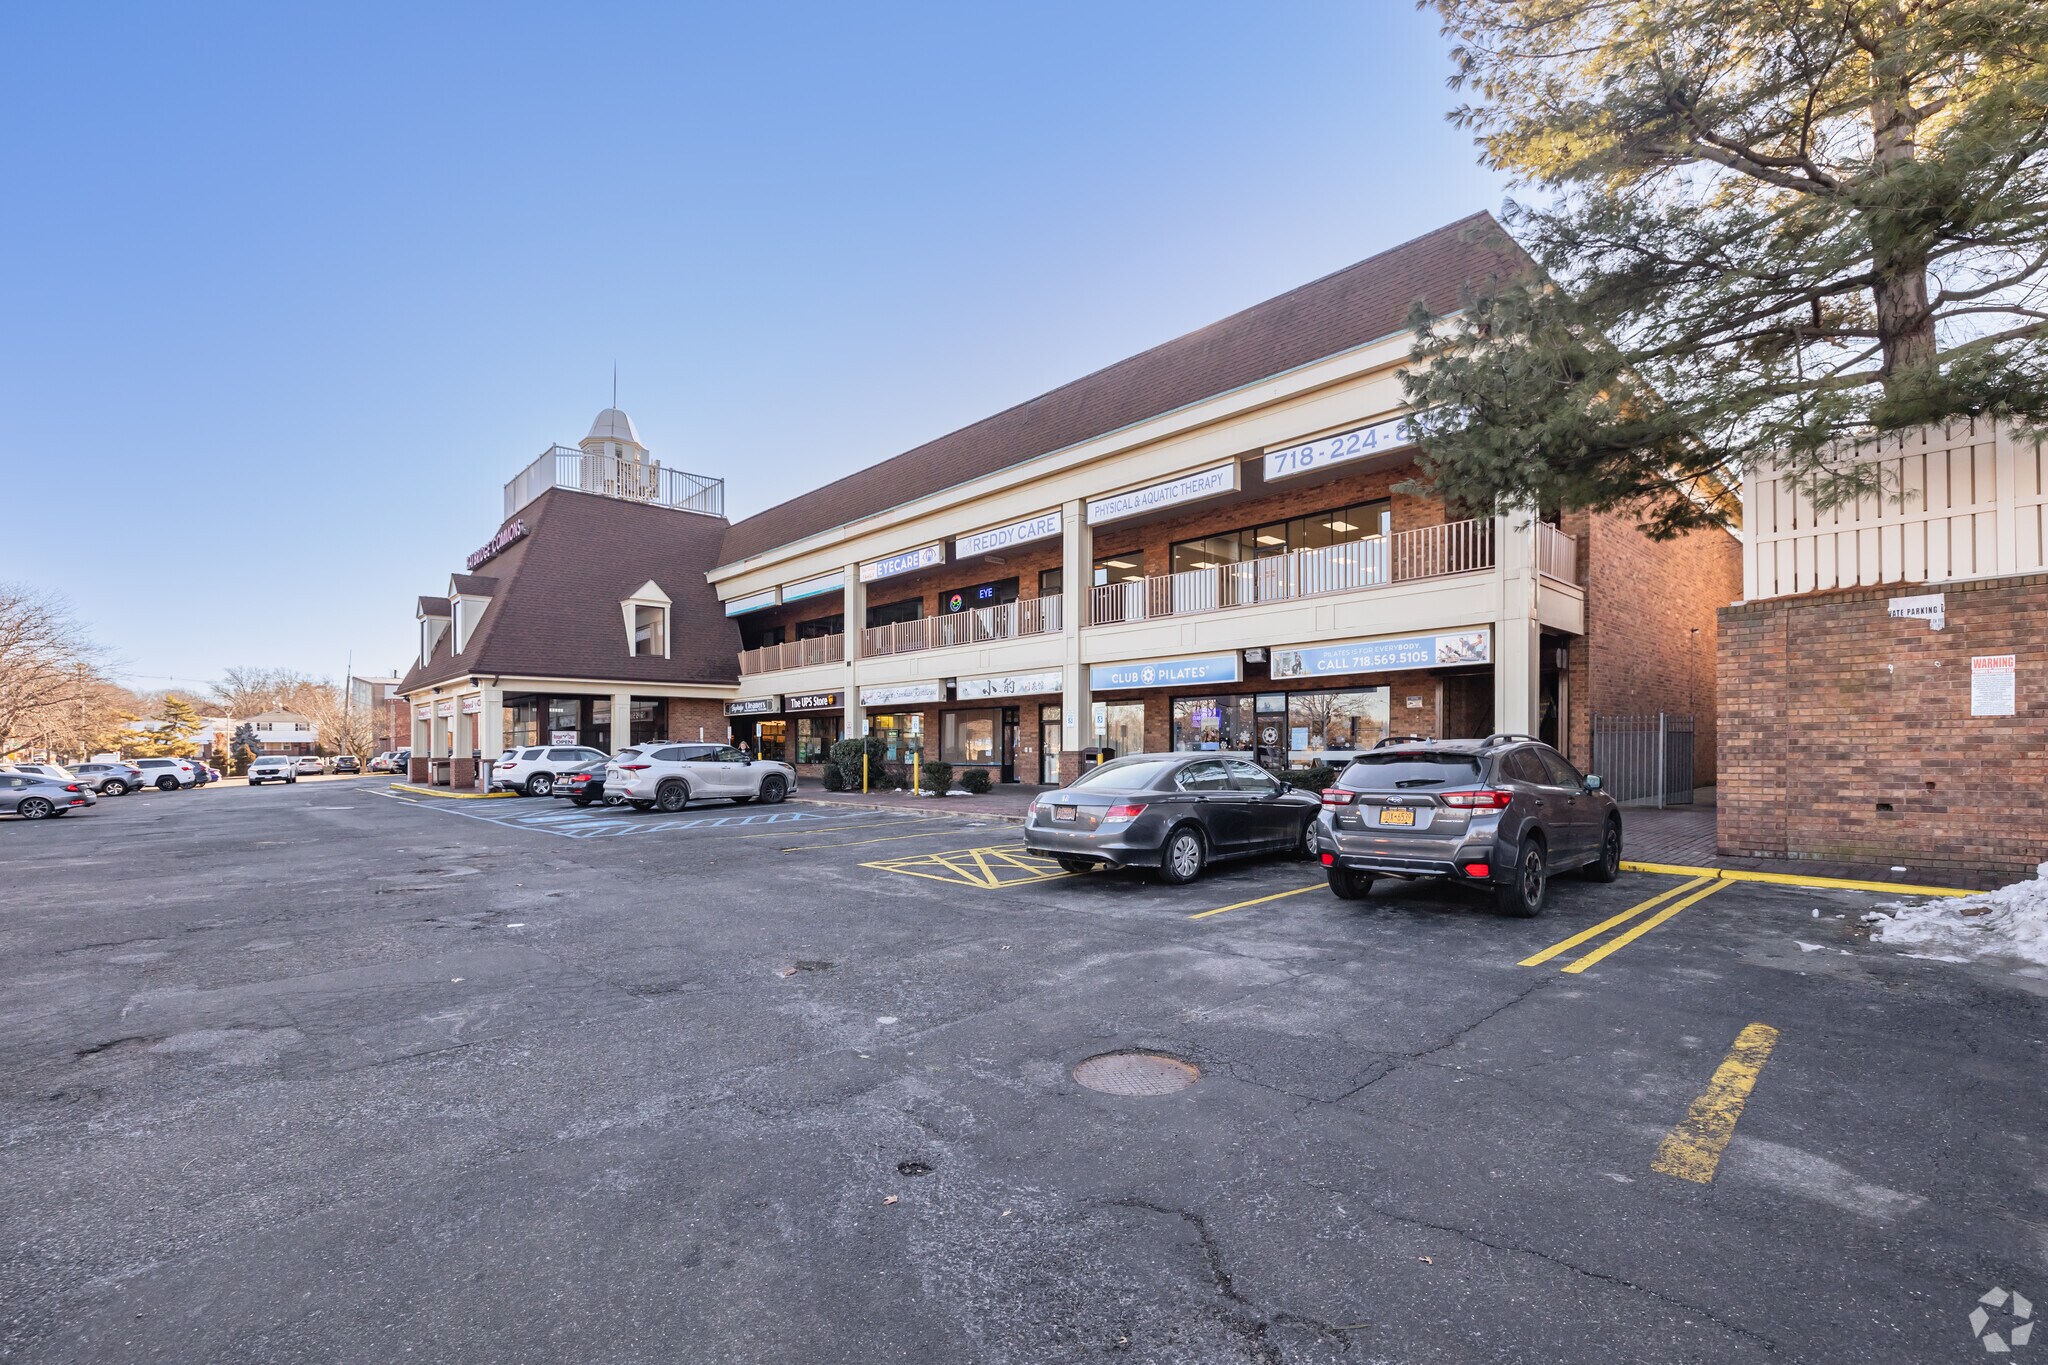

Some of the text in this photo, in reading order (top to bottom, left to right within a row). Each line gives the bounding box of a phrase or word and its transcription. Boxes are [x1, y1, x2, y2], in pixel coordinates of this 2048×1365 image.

[1275, 446, 1314, 473] 718
[1330, 428, 1378, 459] 224
[1094, 472, 1224, 517] PHYSICAL & AQUATIC THERAPY
[491, 518, 521, 553] COMMONS
[972, 516, 1056, 552] REDDY CARE
[877, 552, 919, 577] EYECARE
[979, 587, 993, 599] EYE
[1906, 605, 1938, 616] PARKING
[1317, 651, 1428, 670] CALL 718.569.5105
[1973, 656, 2014, 669] WARNING
[1111, 666, 1206, 683] CLUB PILATES
[790, 695, 829, 708] The UPS Store
